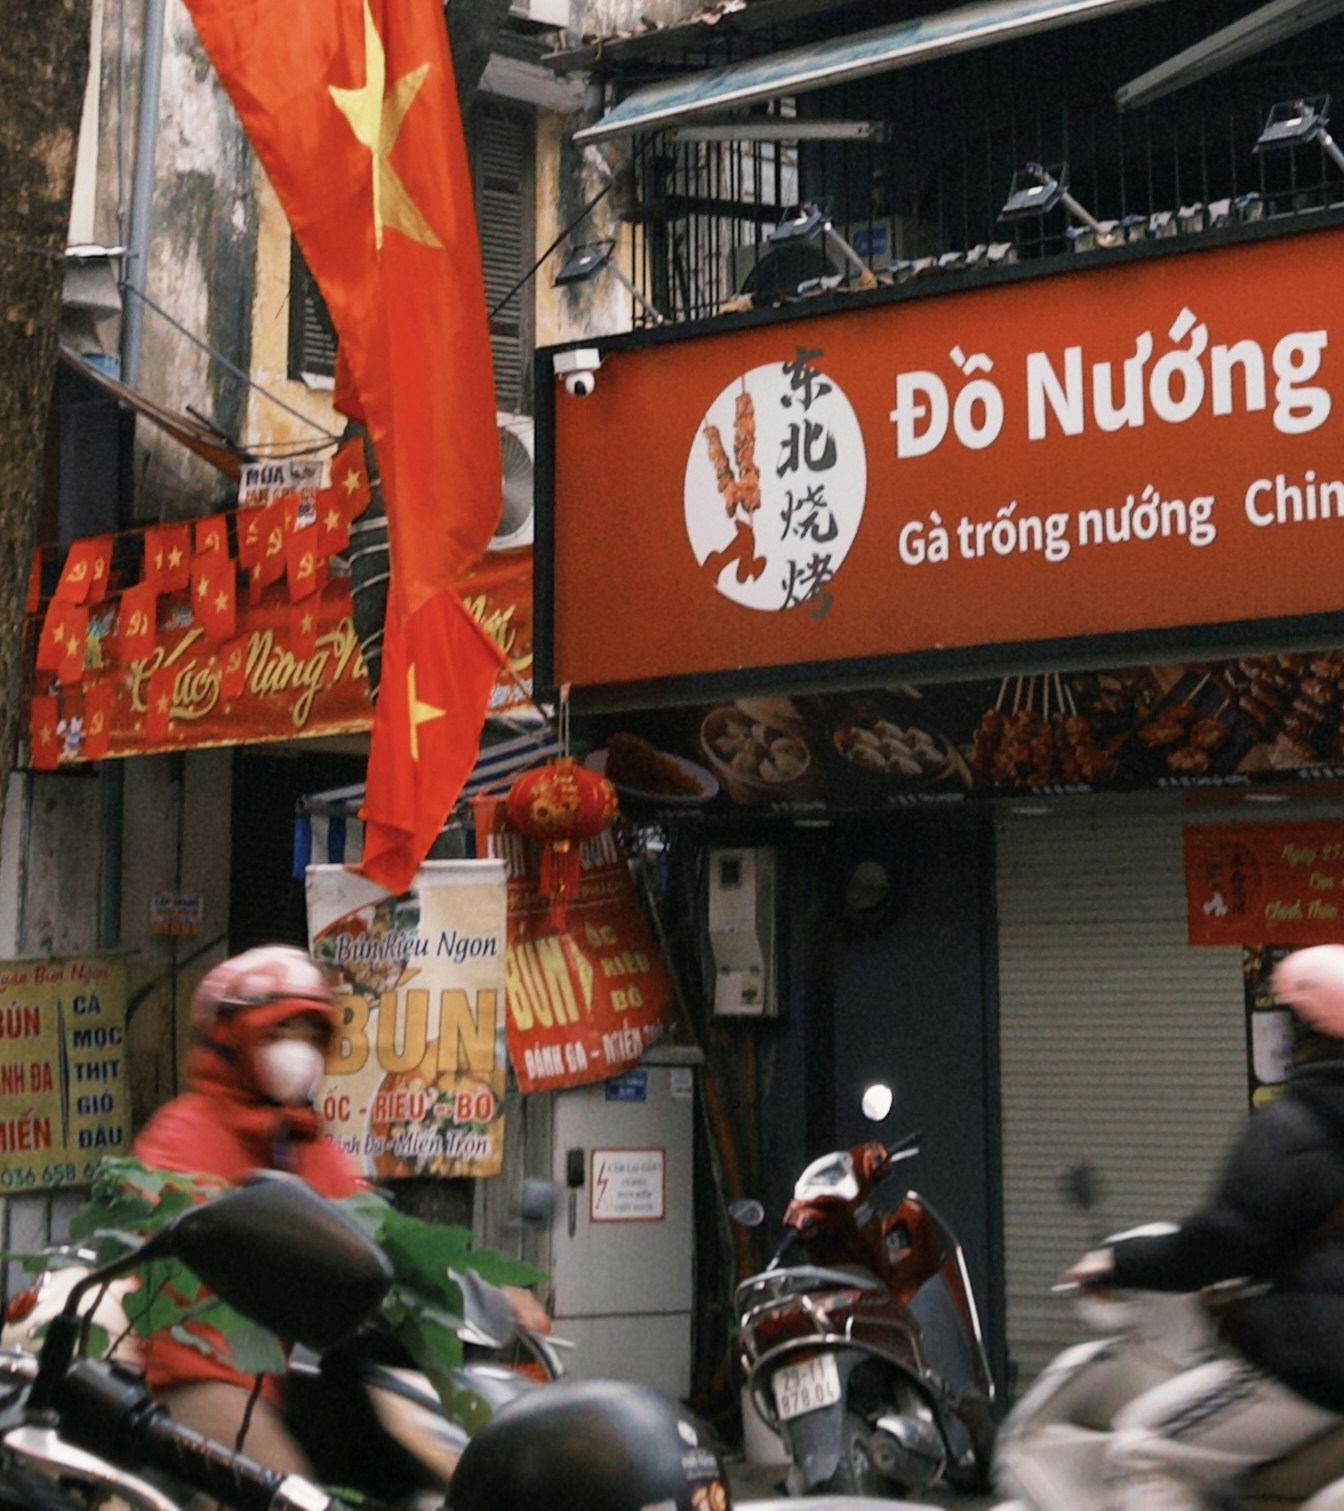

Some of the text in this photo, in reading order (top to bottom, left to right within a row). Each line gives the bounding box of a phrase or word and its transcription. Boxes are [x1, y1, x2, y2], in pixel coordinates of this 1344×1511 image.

[890, 346, 1004, 458] Đồ
[1027, 308, 1331, 440] Nướng
[775, 345, 839, 621] 东北烧烤
[899, 483, 1216, 565] Gà trống nướng
[436, 930, 499, 964] Ngon
[73, 1026, 124, 1051] MỌC
[328, 968, 498, 1075] BÚN
[30, 1060, 54, 1094] ĐA
[74, 1059, 121, 1085] THỊT
[323, 1085, 351, 1122] ỐC
[0, 1166, 36, 1187] 036
[43, 1162, 76, 1184] 658
